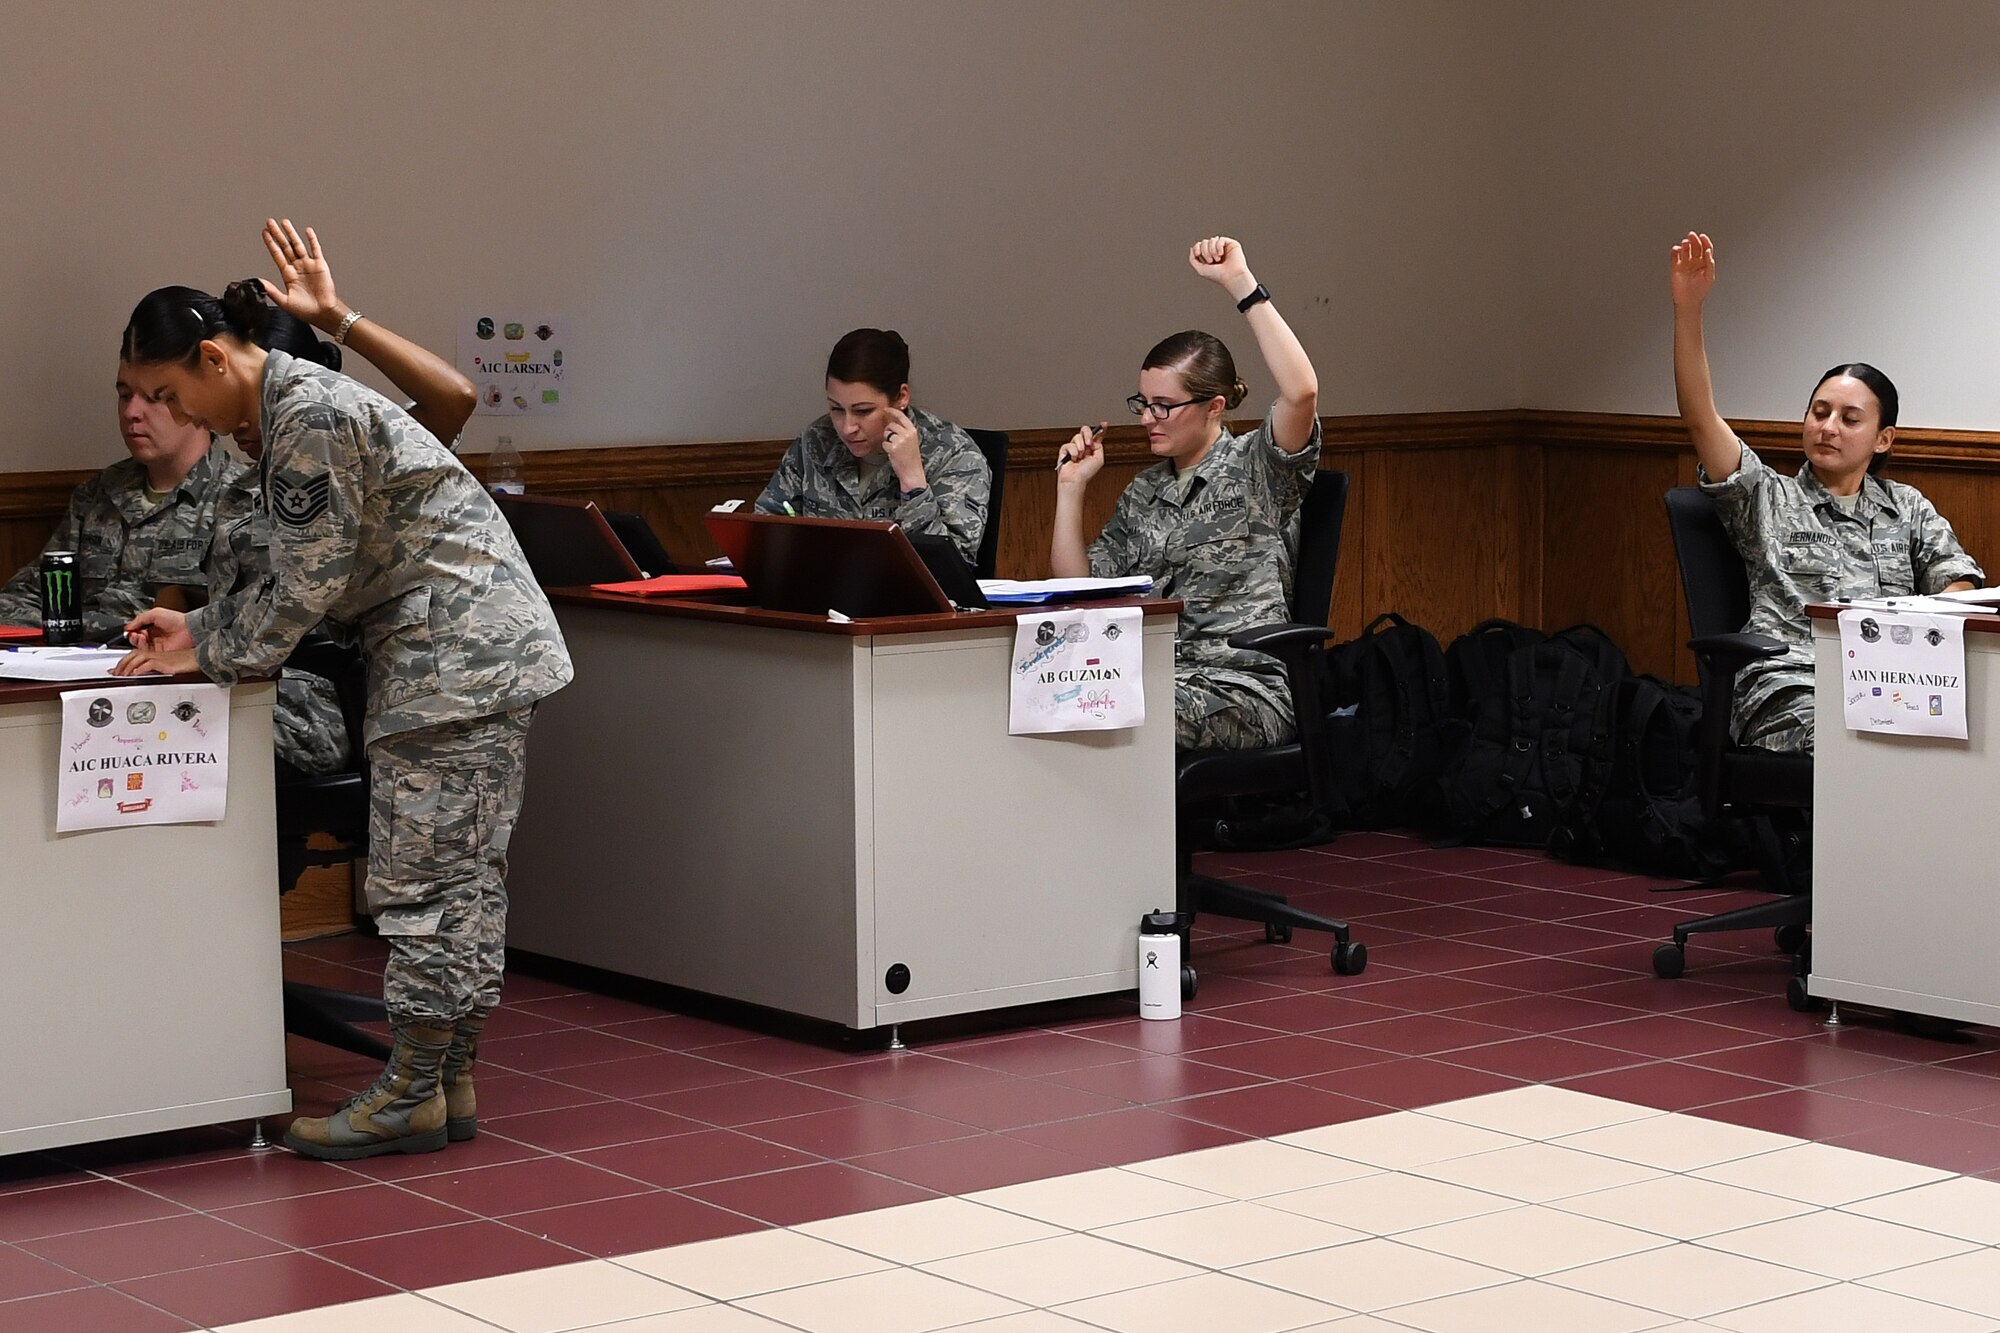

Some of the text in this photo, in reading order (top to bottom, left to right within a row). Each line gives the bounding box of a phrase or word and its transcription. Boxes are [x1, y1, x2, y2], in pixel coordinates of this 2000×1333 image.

[504, 362, 551, 374] LARSEN
[1198, 502, 1213, 515] AIR
[1212, 497, 1244, 512] FORCE
[1891, 542, 1904, 554] AIR
[1037, 667, 1121, 684] AB GUZMAN
[1849, 669, 1959, 689] AMN HERNANDEZ
[100, 753, 153, 770] HUACA
[156, 751, 218, 766] RIVERA
